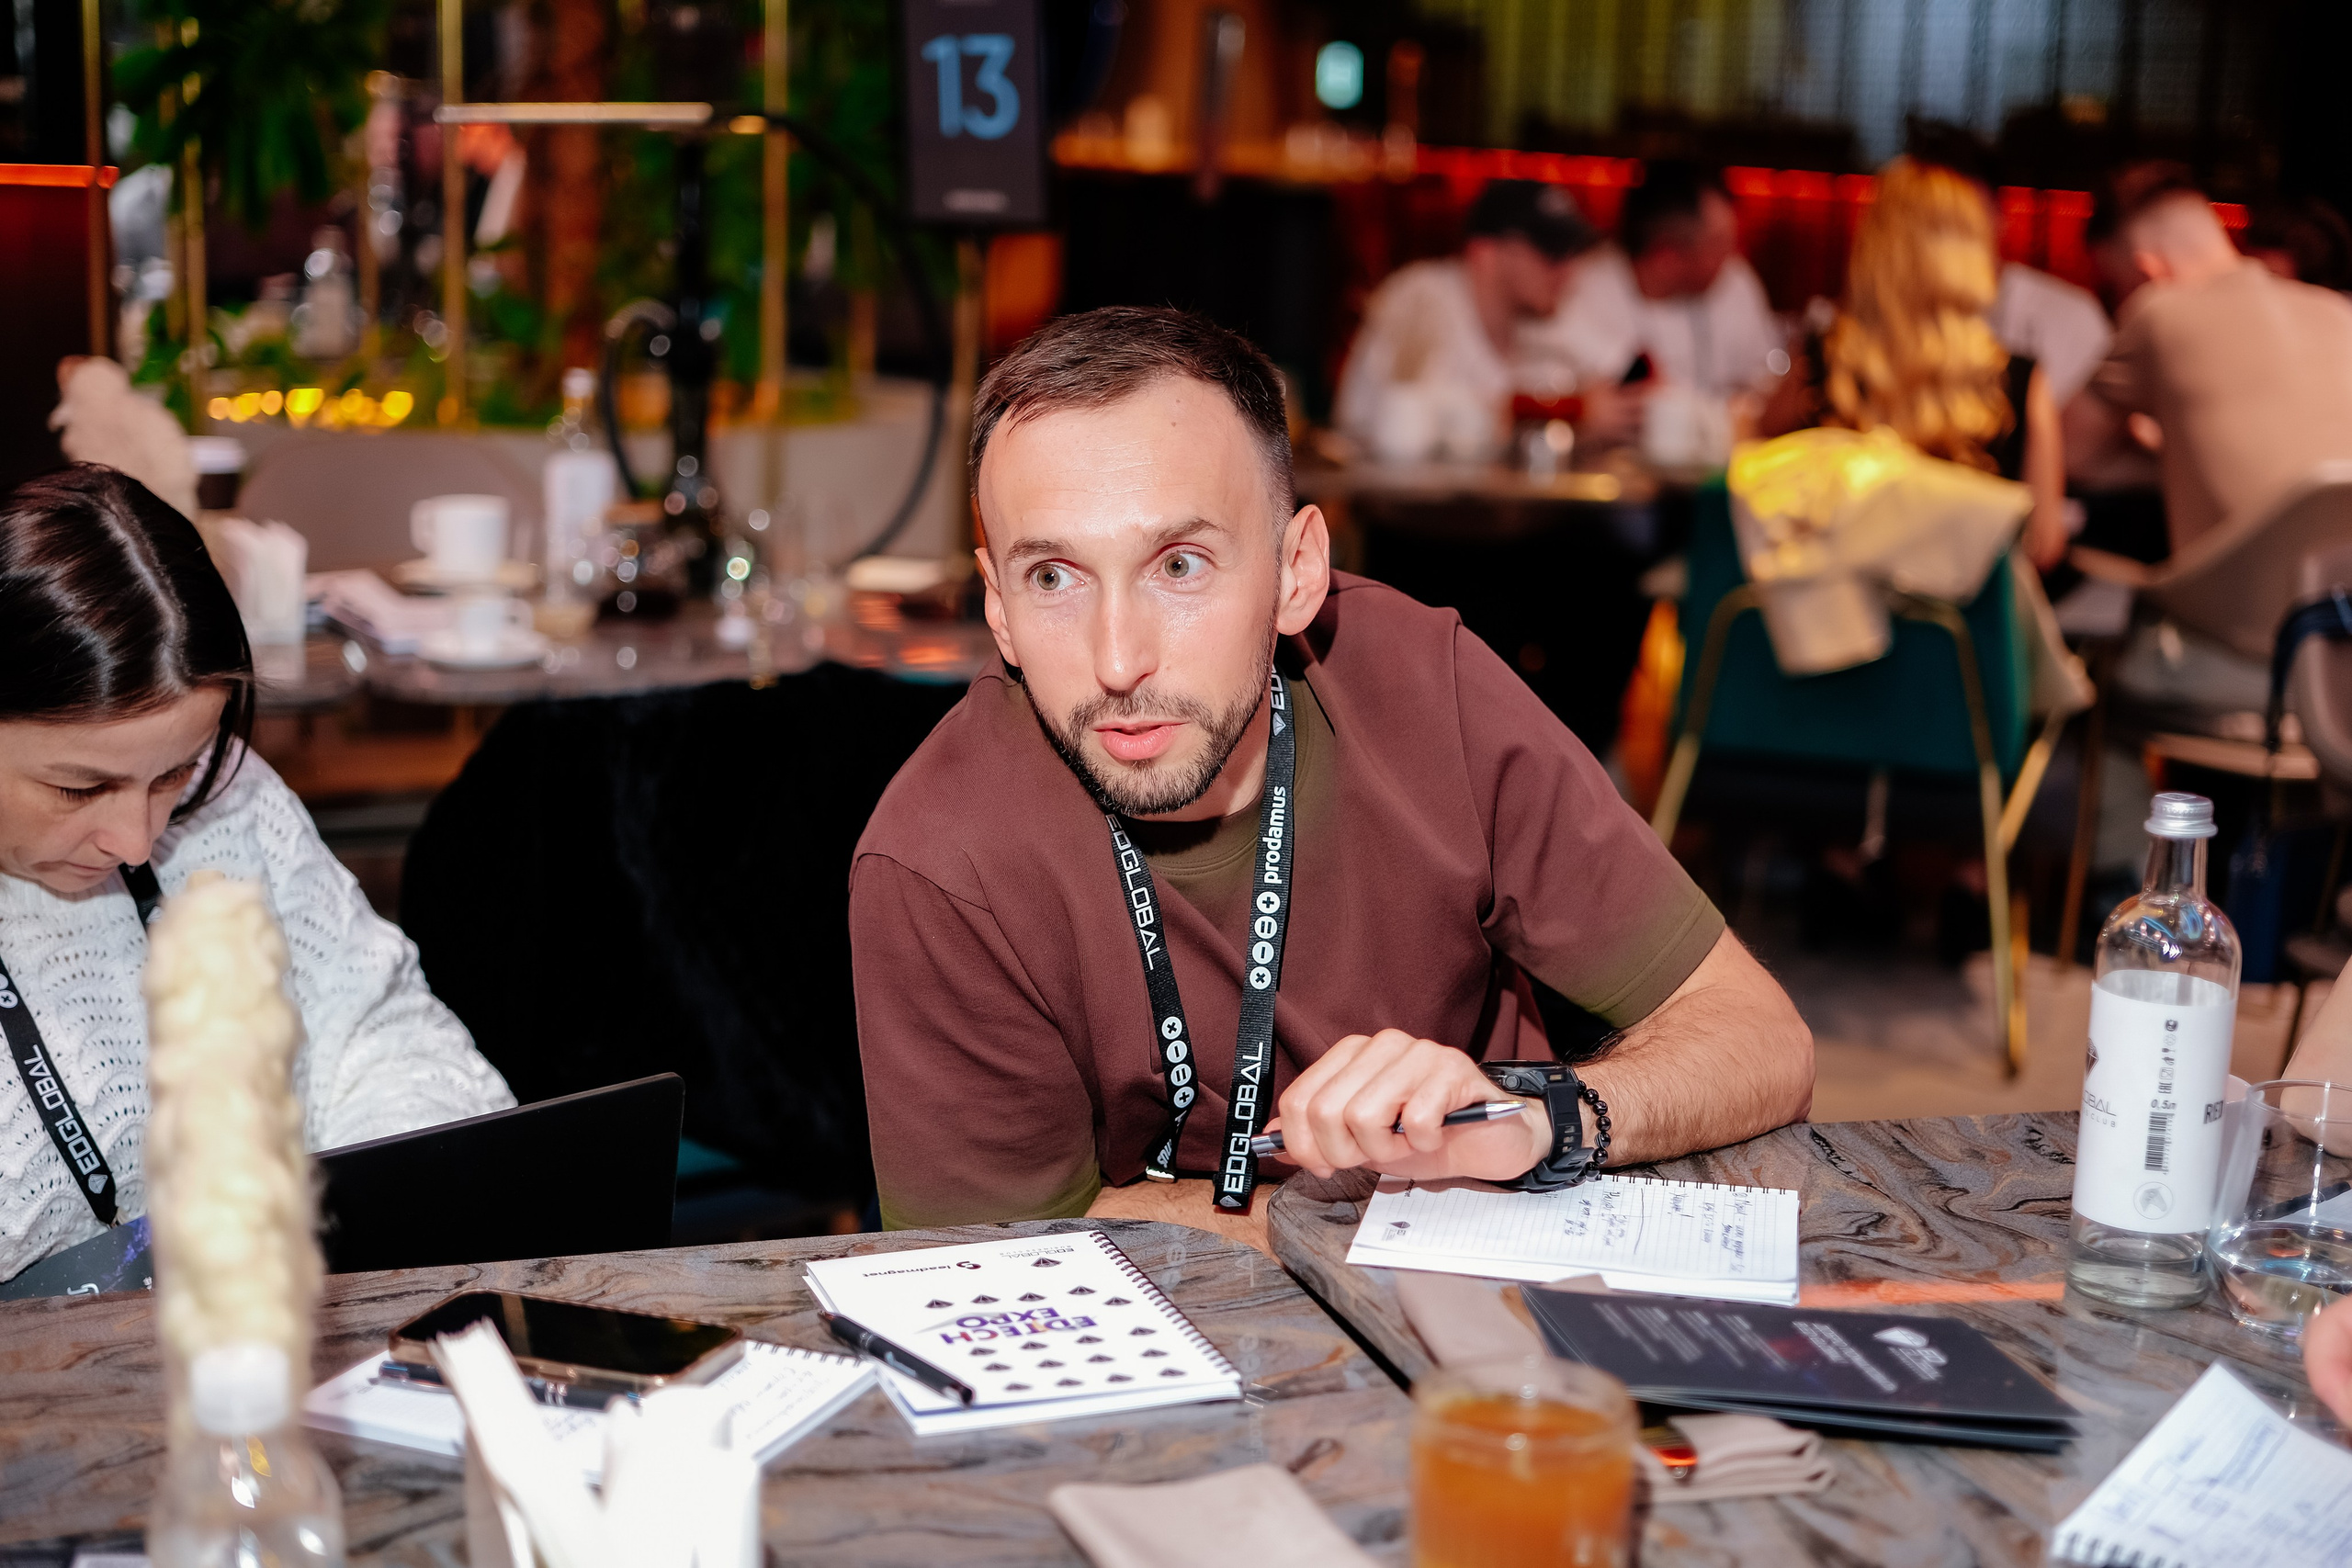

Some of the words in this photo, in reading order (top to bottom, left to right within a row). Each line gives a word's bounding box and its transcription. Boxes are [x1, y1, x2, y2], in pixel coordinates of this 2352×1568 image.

[921, 33, 1020, 140] 13
[1271, 662, 1285, 710] ED
[1262, 785, 1285, 884] prodamus
[1105, 814, 1160, 970] EDGLOBAL
[24, 1043, 101, 1176] EDGLOBAL
[1223, 1042, 1263, 1193] EDGLOBAL
[863, 1264, 952, 1278] leadmagnet
[1001, 1247, 1074, 1259] EDGLOBAL
[939, 1315, 1097, 1344] EDTECH
[956, 1307, 1060, 1328] EXPO
